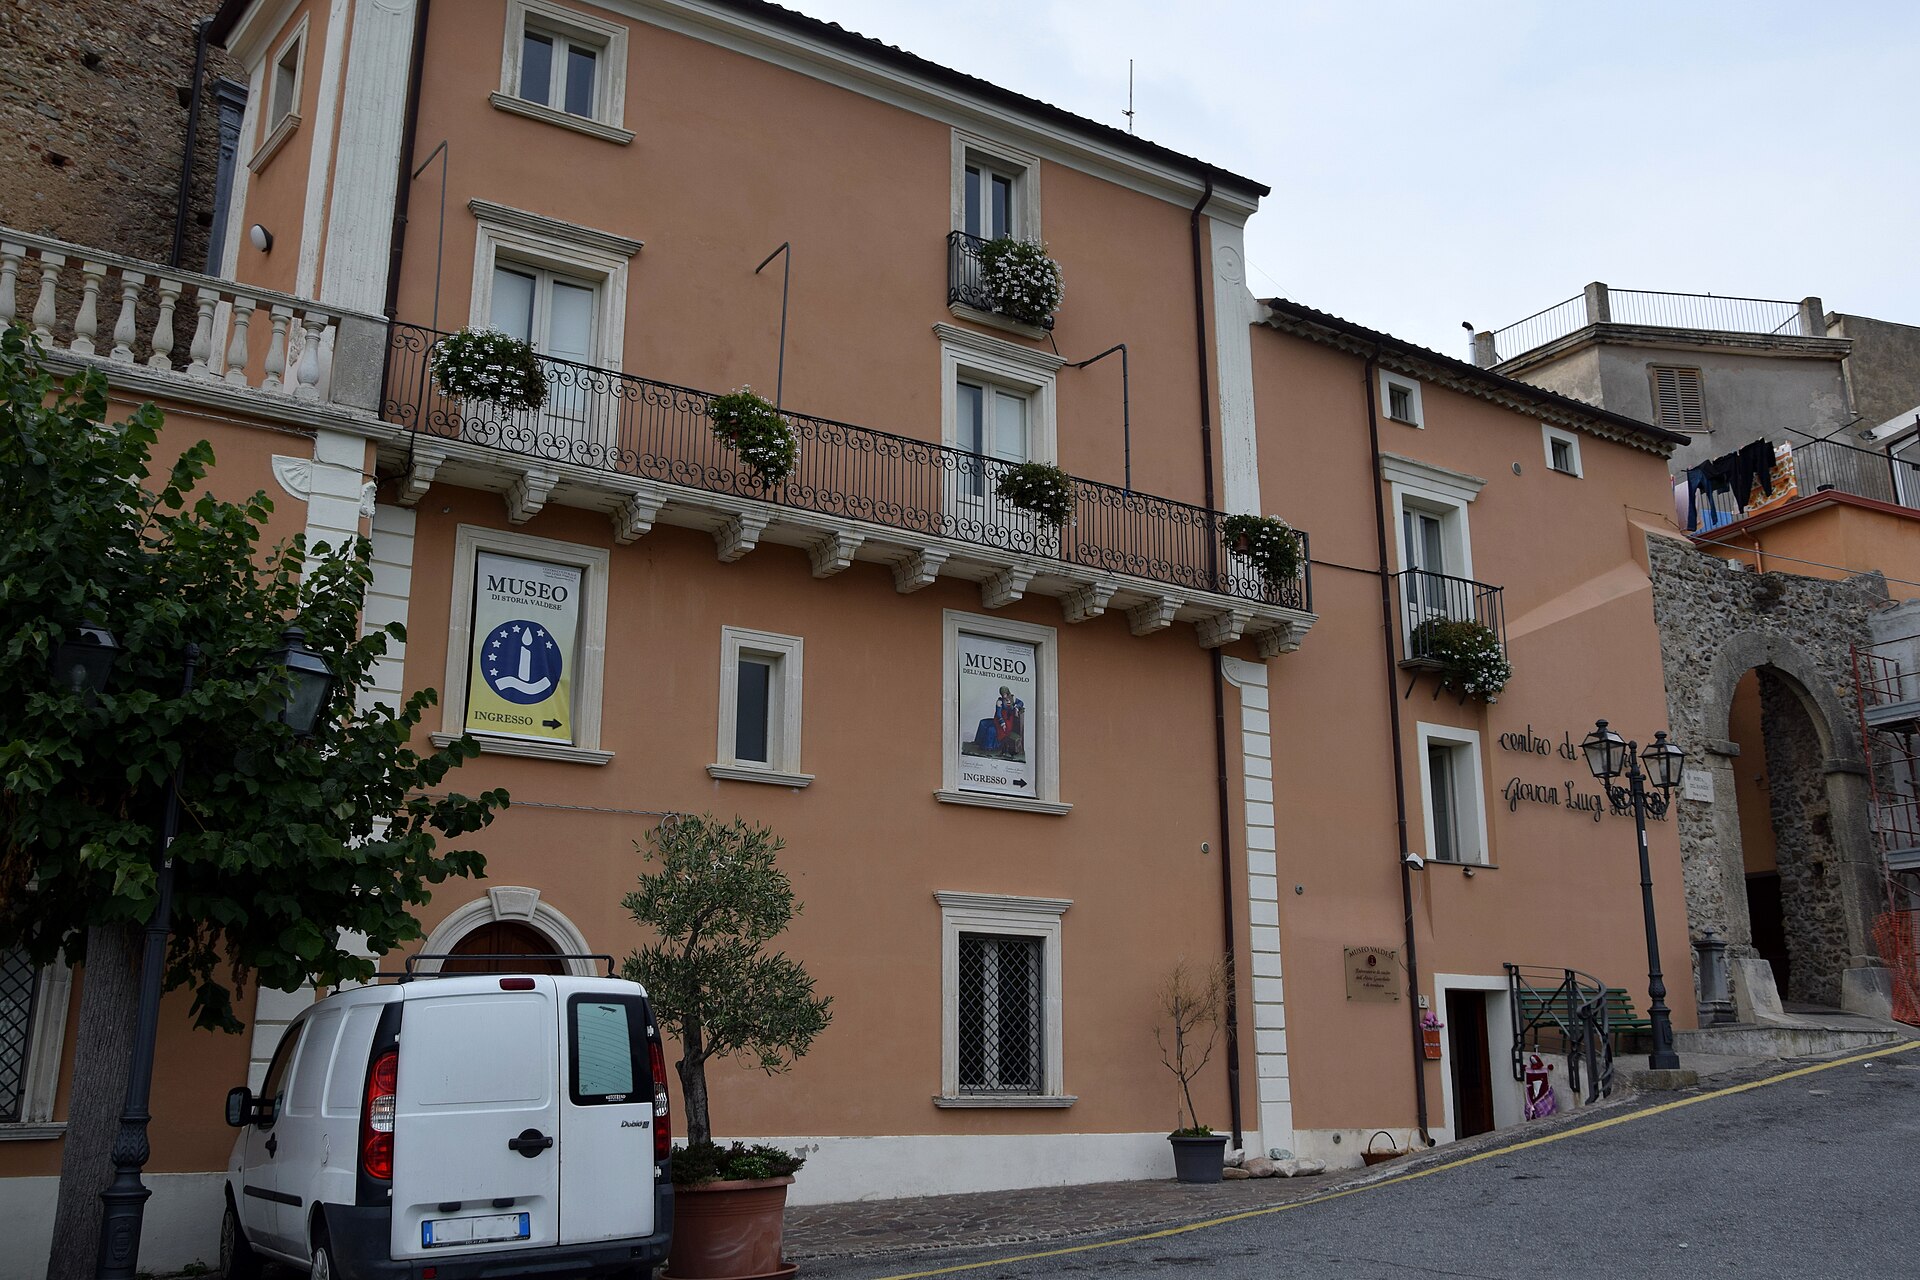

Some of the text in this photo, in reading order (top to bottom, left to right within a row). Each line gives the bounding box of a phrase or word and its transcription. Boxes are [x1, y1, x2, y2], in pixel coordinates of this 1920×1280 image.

[486, 574, 568, 603] MUSEO
[491, 593, 562, 611] DI STORIA VALDESE
[965, 652, 1026, 675] MUSEO
[962, 668, 1030, 683] DELL'ABITO GUARDIOLO
[474, 710, 533, 726] INGRESSO
[1498, 724, 1551, 756] centro
[963, 772, 1007, 785] INGRESSO
[1349, 946, 1369, 958] MUSEO
[1420, 995, 1425, 1006] 2
